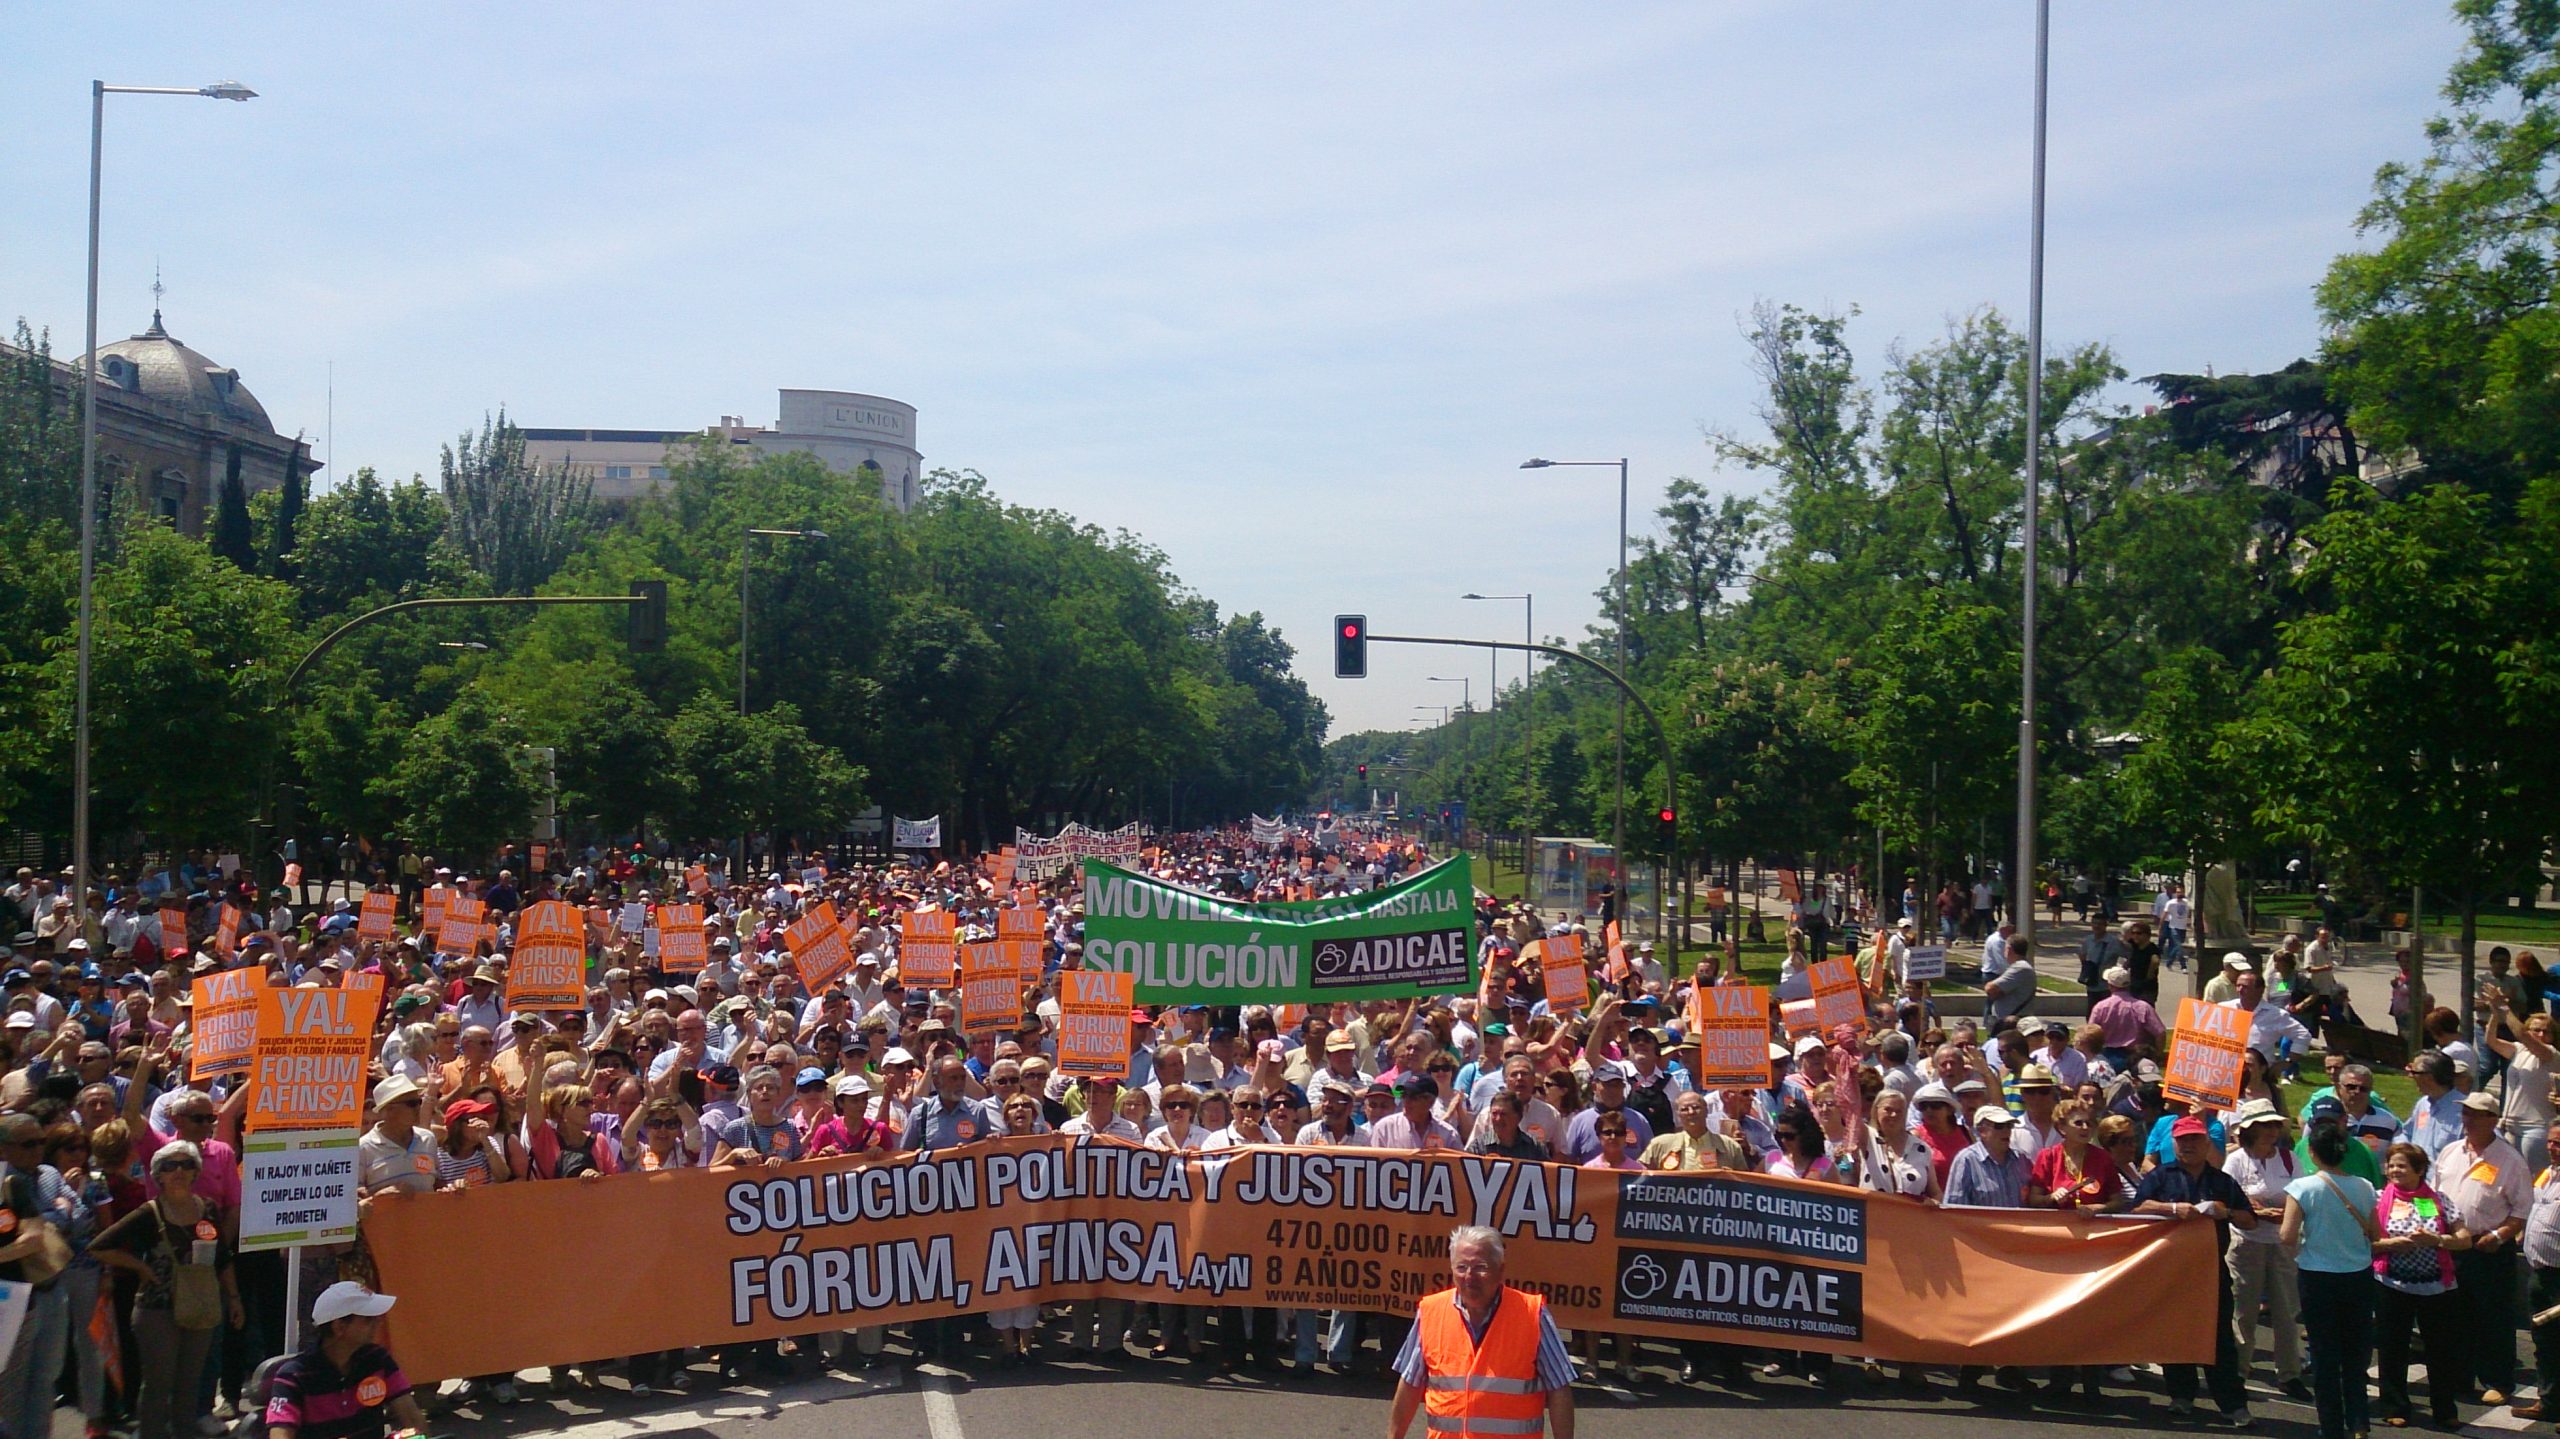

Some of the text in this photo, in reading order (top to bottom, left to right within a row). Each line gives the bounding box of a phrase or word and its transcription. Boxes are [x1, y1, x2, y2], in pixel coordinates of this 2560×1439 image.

[1018, 843, 1034, 856] NO
[1036, 844, 1062, 857] NOS
[1018, 856, 1063, 869] JUSTICIA
[1435, 889, 1458, 912] LA
[665, 907, 697, 925] YA!
[911, 914, 943, 935] YA!
[663, 932, 702, 945] FORUM
[514, 946, 580, 969] FORUM
[666, 944, 703, 957] AFINSA
[800, 933, 841, 968] FORUM
[906, 944, 950, 957] FORUM
[970, 943, 1006, 969] YA!
[1085, 932, 1298, 988] SOLUCIÓN
[1349, 931, 1465, 974] ADICAE
[805, 945, 847, 980] AFINSA
[905, 958, 950, 971] AFINSA
[512, 965, 579, 986] AFINSA
[204, 970, 249, 1005] YA!
[966, 979, 1016, 998] FORUM
[1074, 974, 1117, 1002] YA!
[279, 991, 349, 1035] YA!
[966, 994, 1017, 1013] AFINSA
[1712, 989, 1754, 1017] YA!
[1065, 1015, 1127, 1034] FORUM
[2192, 1002, 2236, 1037] YA!
[293, 1036, 327, 1045] POLÍTICA
[328, 1037, 333, 1045] Y
[334, 1037, 366, 1045] JUSTICIA
[1064, 1033, 1126, 1053] AFINSA
[1706, 1029, 1765, 1047] FORUM
[326, 1046, 365, 1055] FAMILIAS
[1706, 1048, 1766, 1066] AFINSA
[2175, 1040, 2239, 1071] FORUM
[260, 1056, 360, 1084] FORUM
[2171, 1059, 2235, 1088] AFINSA
[255, 1084, 356, 1113] AFINSA
[254, 1160, 351, 1180] NI RAJOY NI CAÑETE
[261, 1184, 344, 1203] CUMPLEN LO QUE
[727, 1136, 1576, 1239] SOLUCIÓN POLÍTICA Y JUSTICIA YA!
[1626, 1183, 1859, 1226] FEDERACIÓN DE CLIENTES DE
[276, 1208, 328, 1226] PROMETEN
[1267, 1218, 1389, 1254] 470.000
[1623, 1211, 1858, 1254] AFINSA Y FÓRUM FILATÉLICO
[732, 1236, 972, 1326] FÓRUM,
[985, 1219, 1184, 1292] AFINSA,
[1266, 1255, 1283, 1285] 8
[1295, 1250, 1381, 1290] AÑOS
[1390, 1269, 1424, 1296] SIN
[1672, 1259, 1838, 1316] ADICAE
[1620, 1303, 1857, 1336] CONSUMIDORES CRÍTICOS, GLOBALES Y SOLIDARIOS
